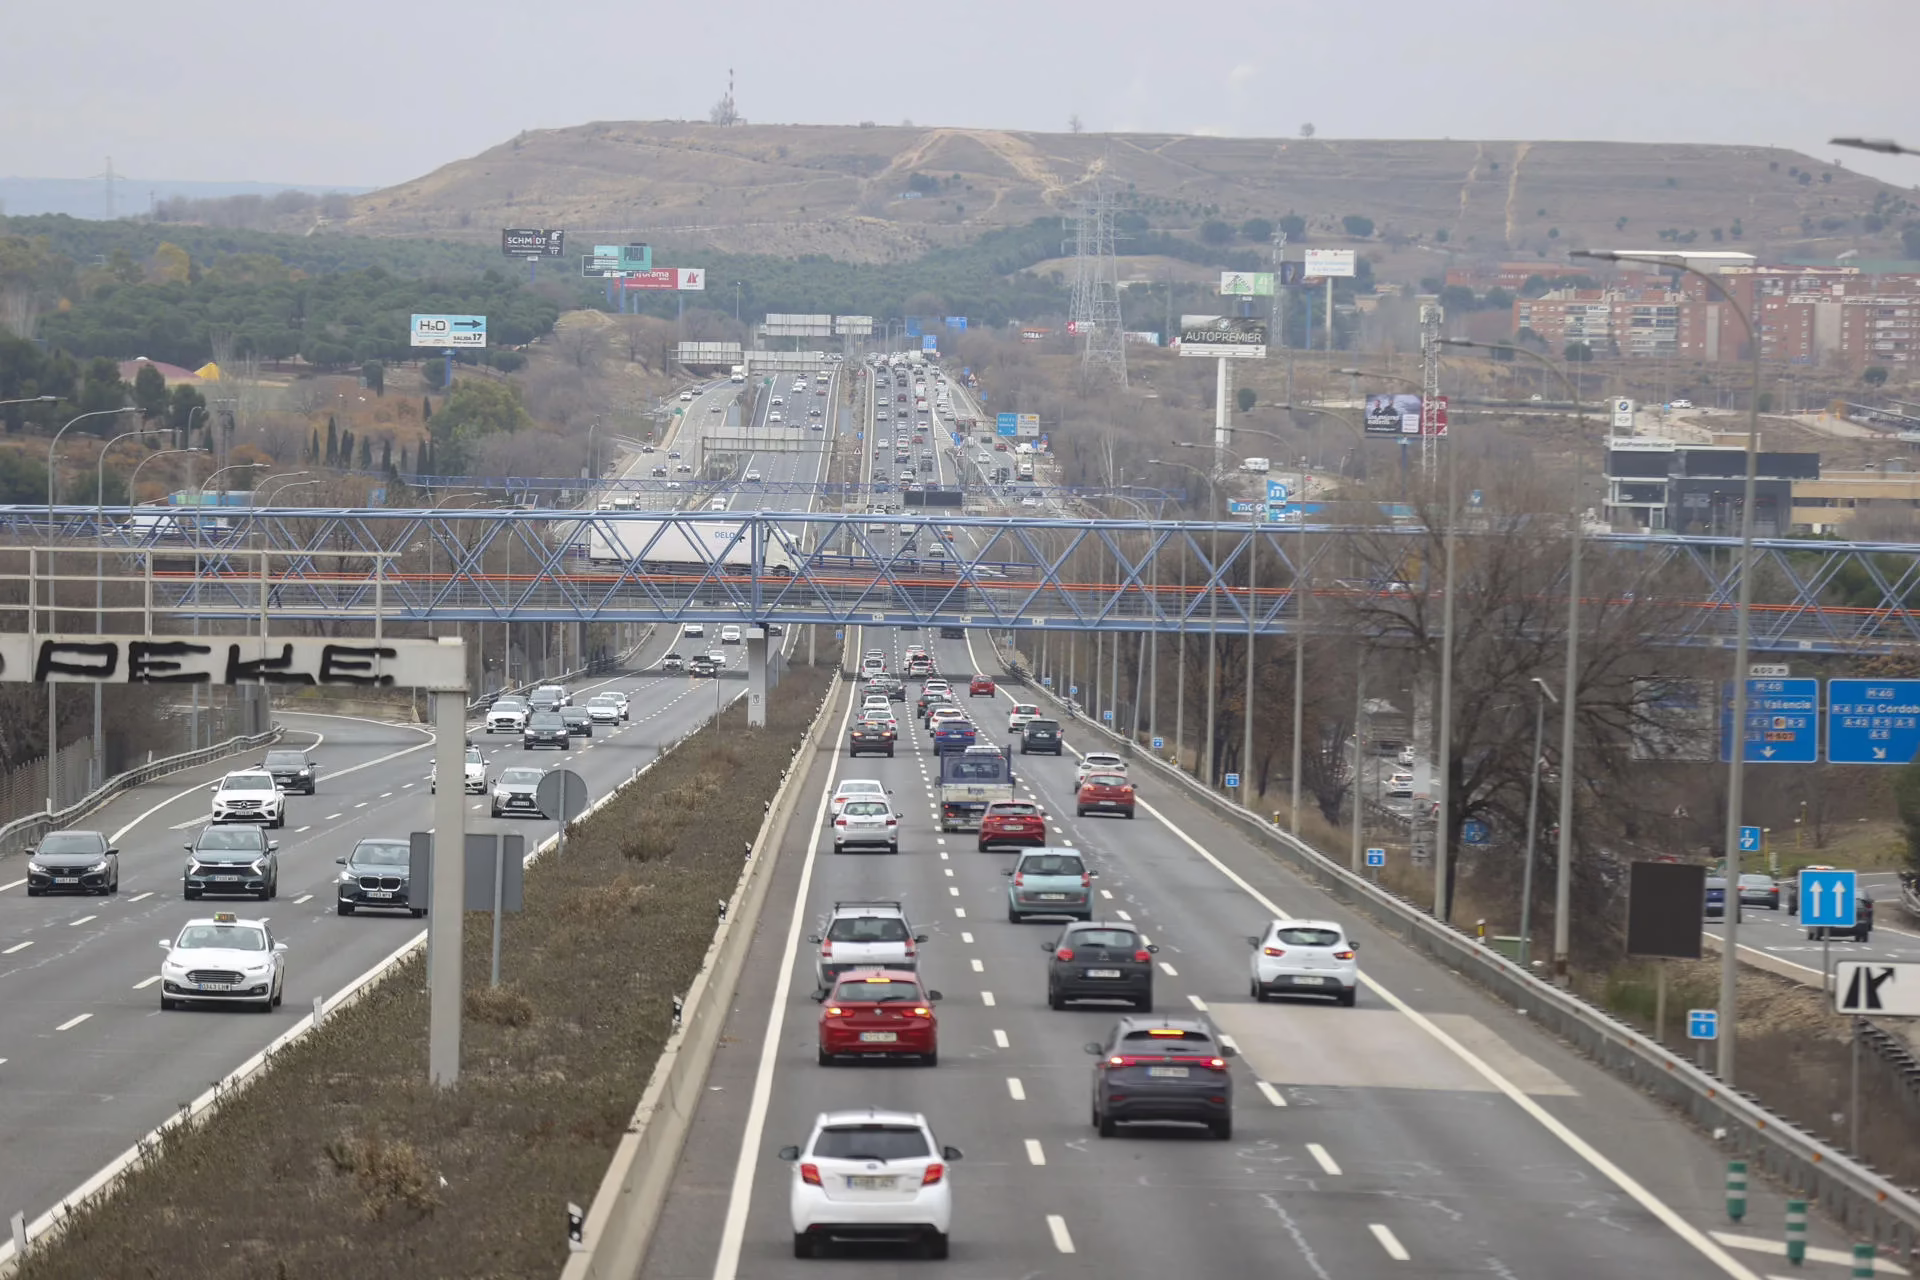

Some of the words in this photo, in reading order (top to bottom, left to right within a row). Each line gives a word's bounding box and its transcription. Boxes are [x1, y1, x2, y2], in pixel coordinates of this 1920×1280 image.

[472, 333, 483, 341] 17
[1185, 331, 1262, 343] AUTOPREMIER
[1764, 699, 1812, 709] Valencia
